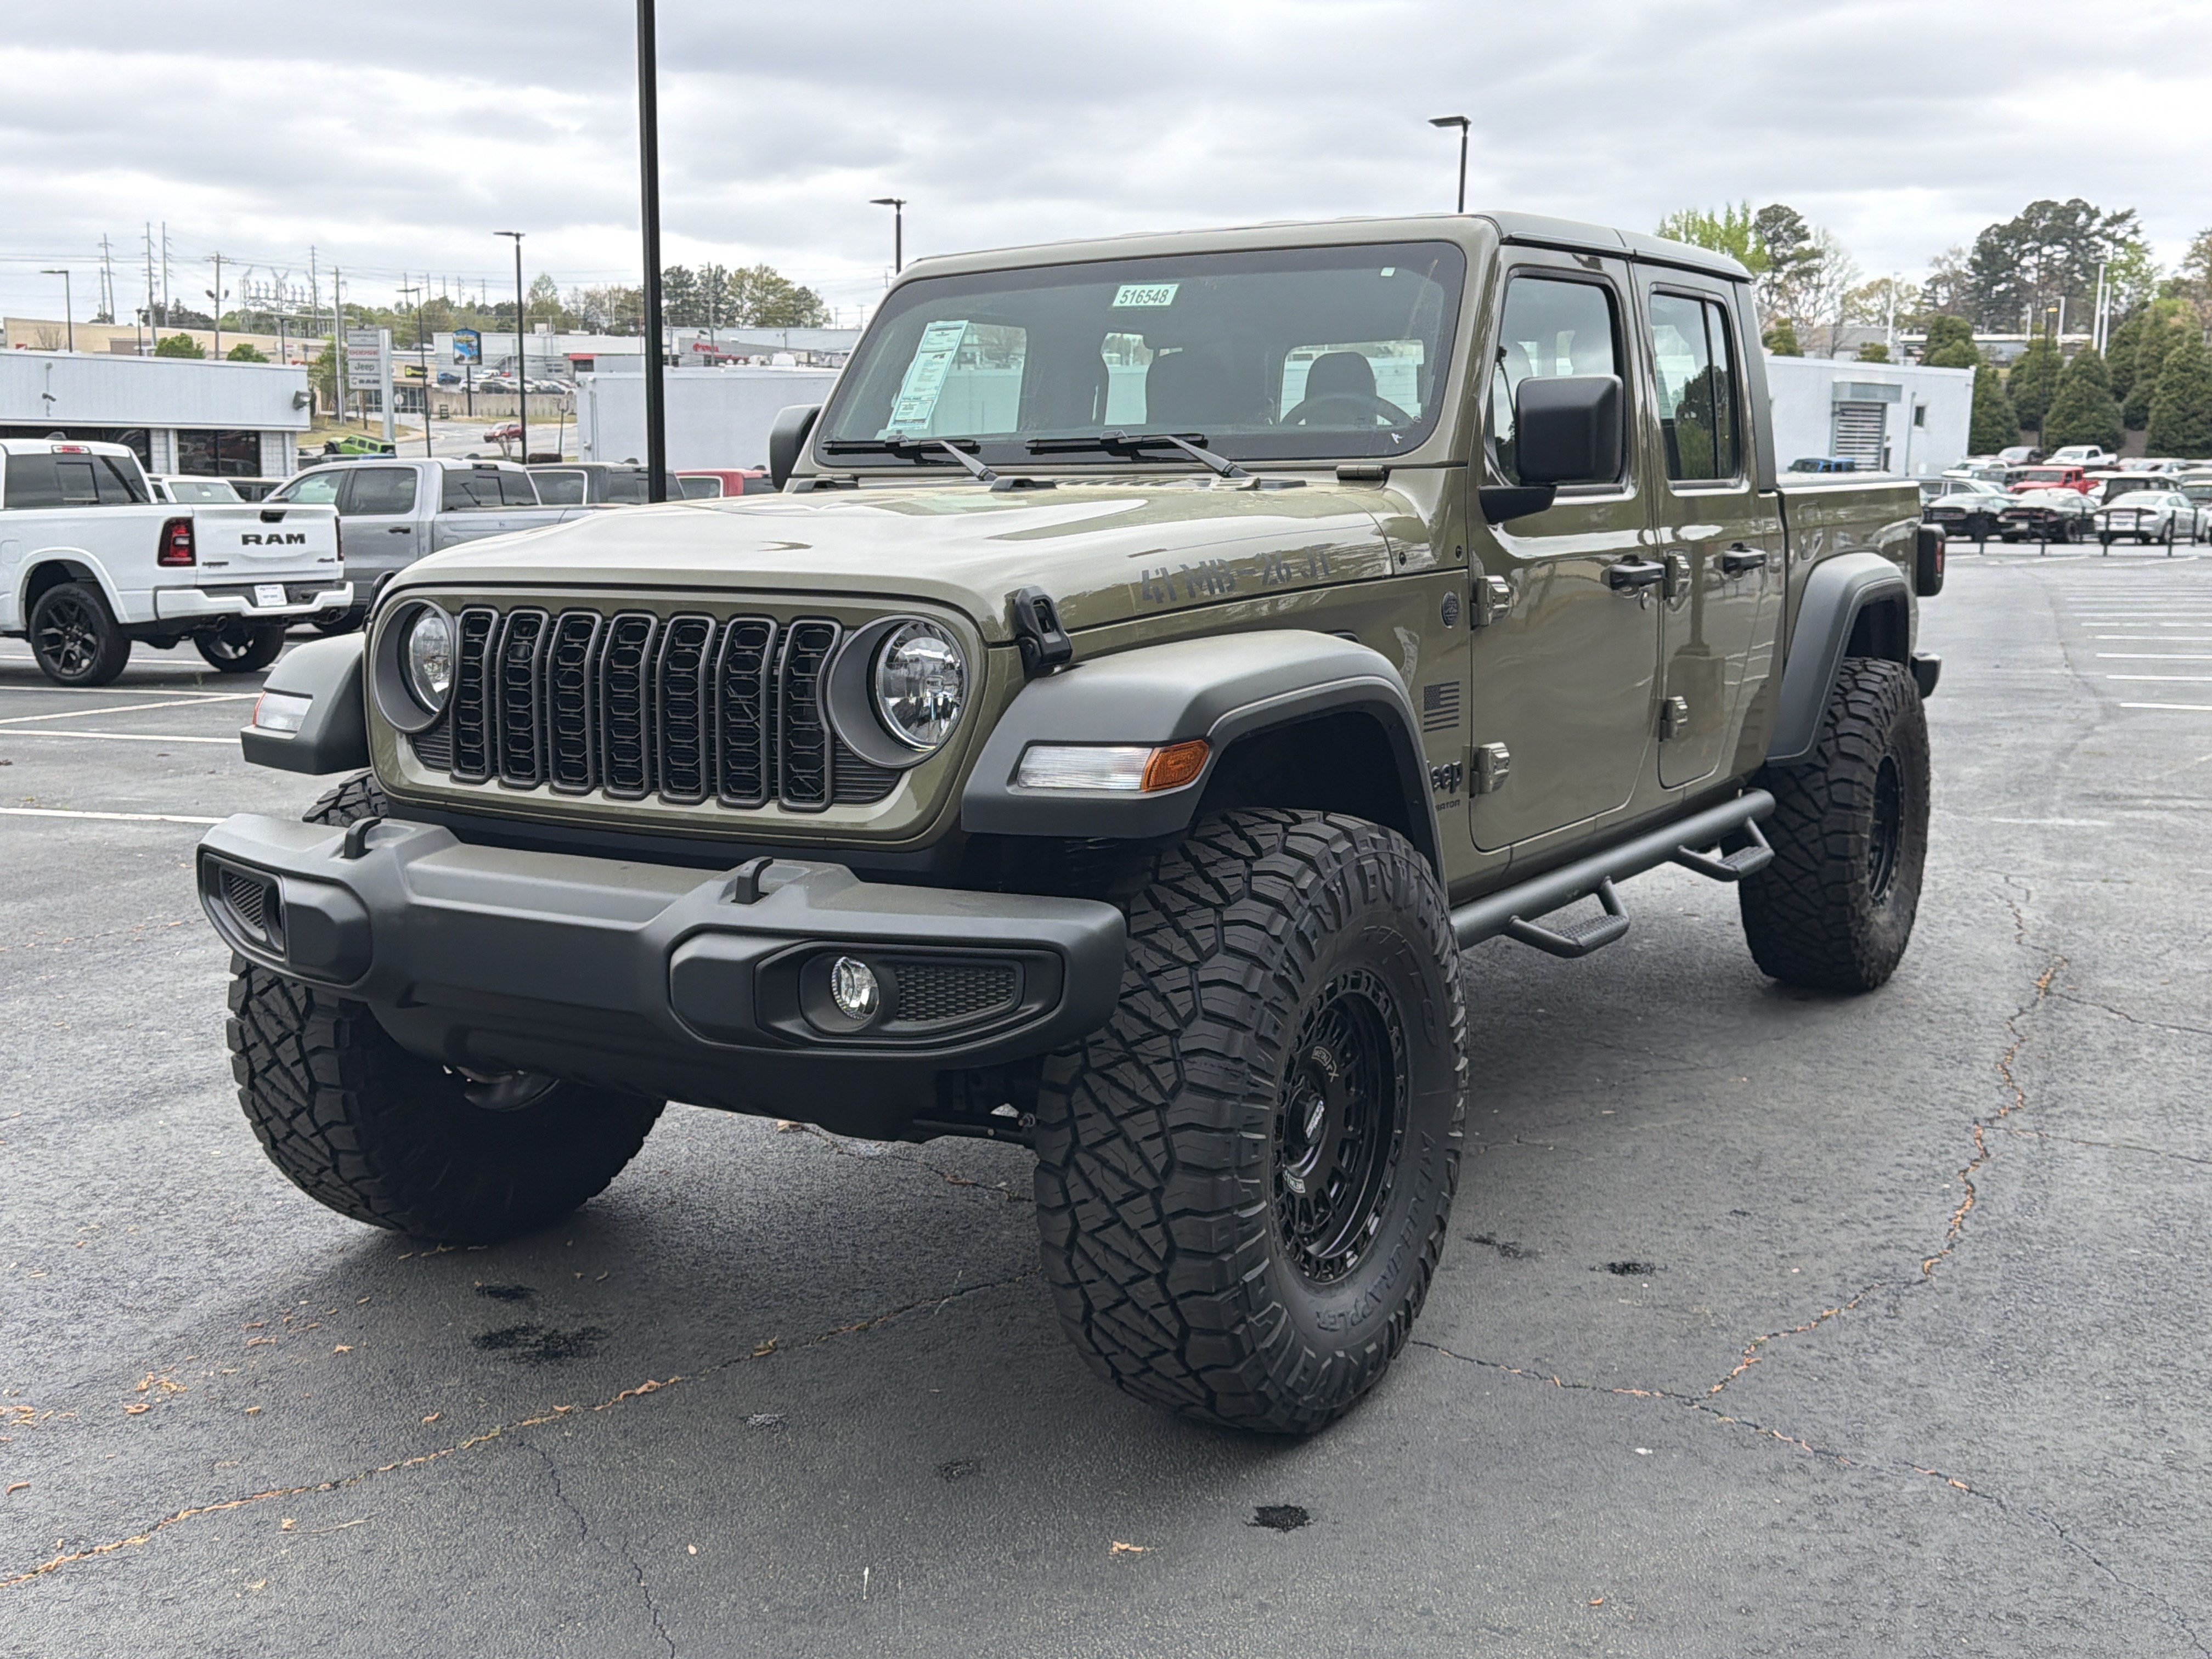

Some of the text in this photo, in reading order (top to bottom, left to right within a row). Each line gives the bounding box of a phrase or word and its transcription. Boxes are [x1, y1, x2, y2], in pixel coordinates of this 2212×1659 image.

[1119, 289, 1170, 304] 516548
[354, 362, 375, 371] Jeep
[241, 533, 306, 545] RAM
